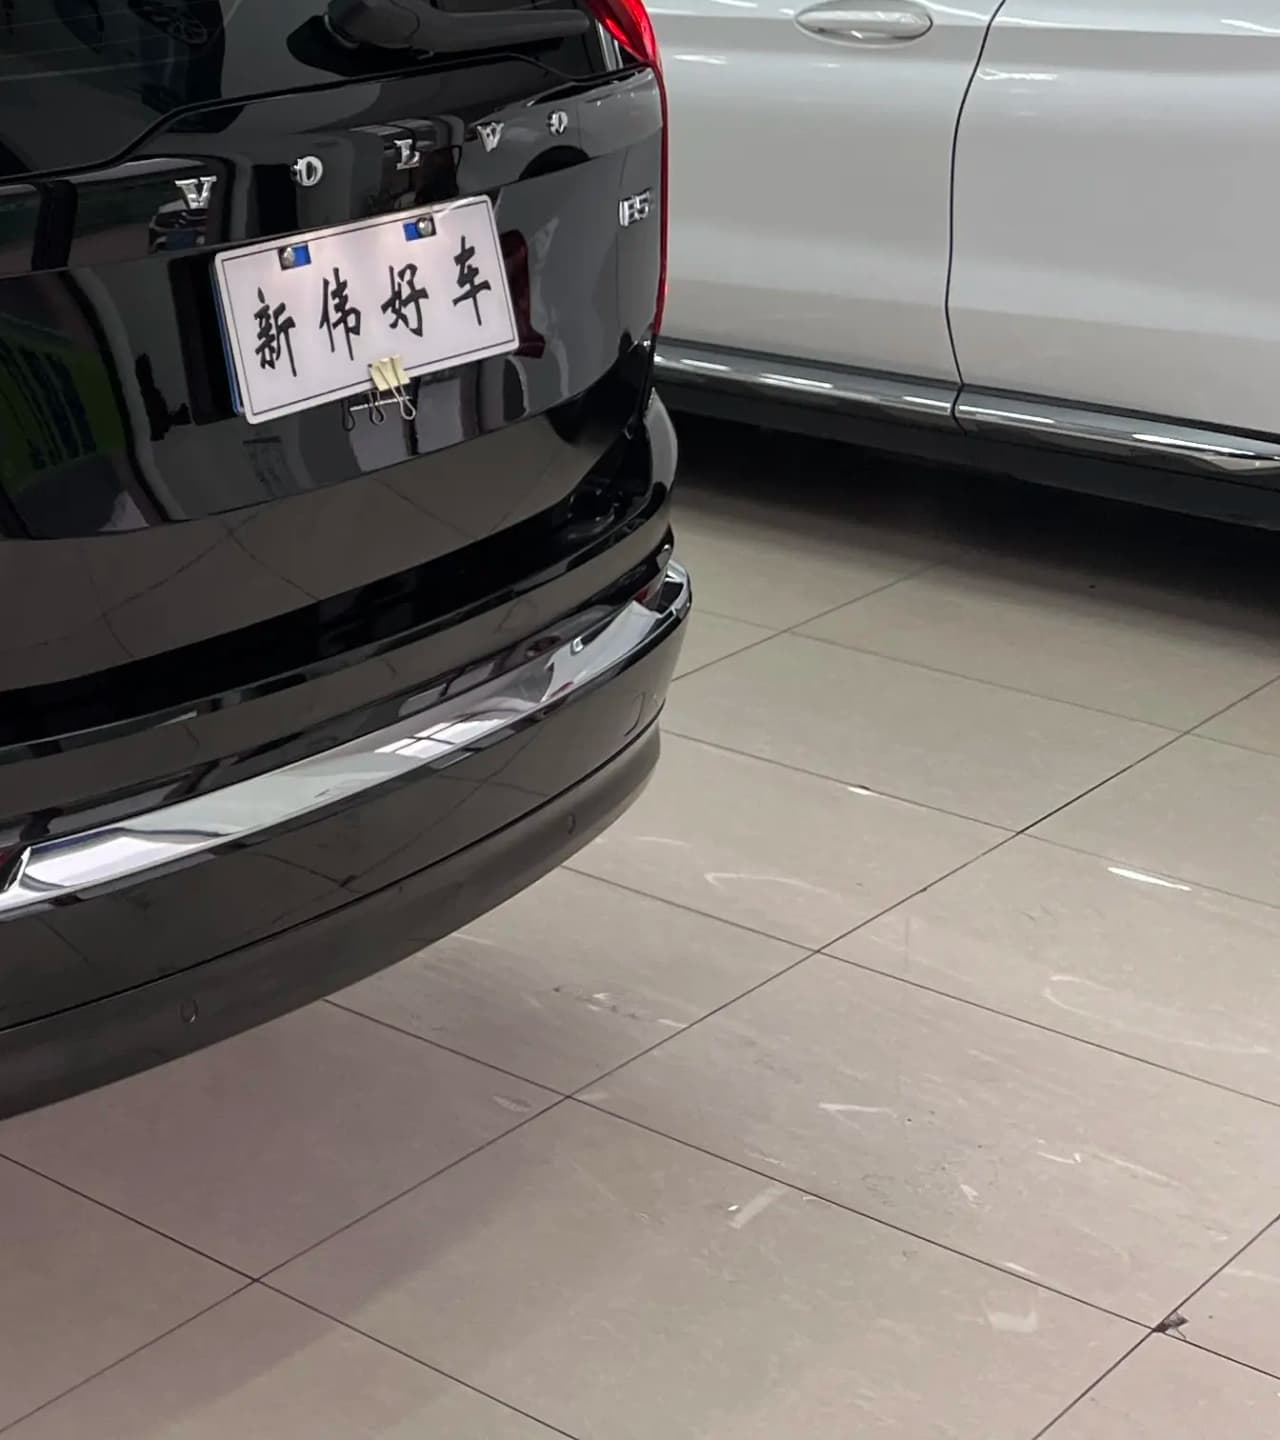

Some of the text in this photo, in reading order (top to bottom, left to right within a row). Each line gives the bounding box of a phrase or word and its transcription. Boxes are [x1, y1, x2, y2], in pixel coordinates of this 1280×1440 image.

[174, 110, 569, 208] VOLVO
[253, 236, 493, 377] 新伟好车
